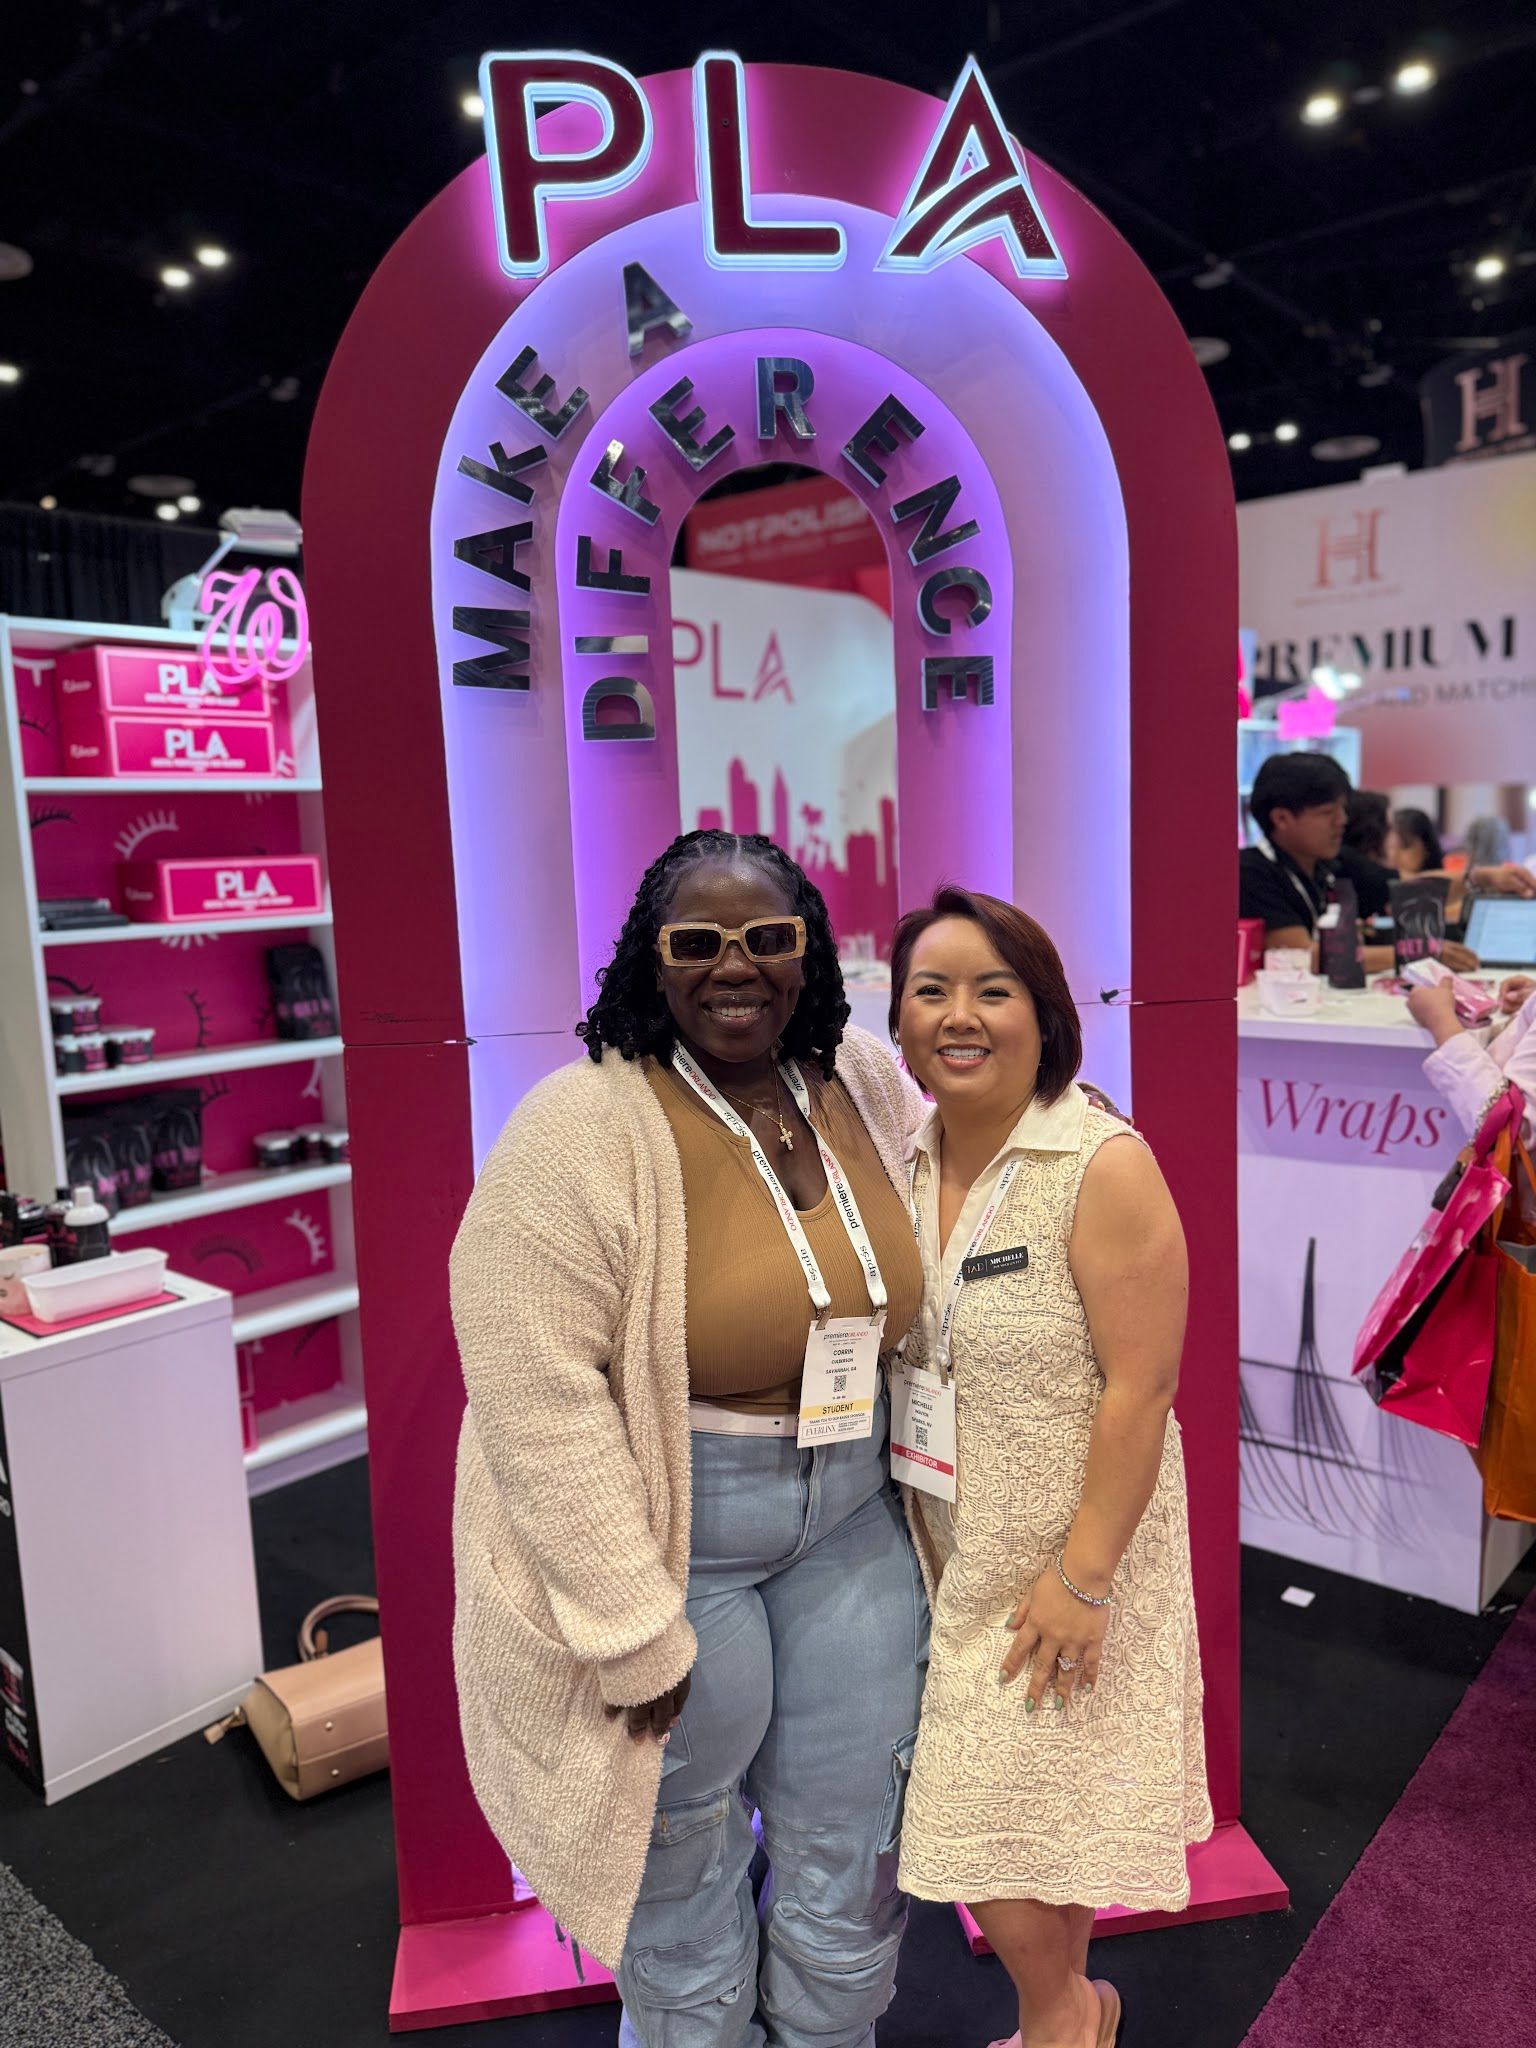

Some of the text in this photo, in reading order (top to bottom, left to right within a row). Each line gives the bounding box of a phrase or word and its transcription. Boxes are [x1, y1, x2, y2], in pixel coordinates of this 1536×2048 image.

[479, 50, 1068, 279] PLA
[453, 261, 694, 692] MAKE A
[575, 356, 995, 743] DIFFERENCE
[158, 663, 223, 697] PLA
[165, 728, 230, 761] PLA
[215, 870, 278, 901] PLA
[1259, 1077, 1447, 1156] Wraps
[990, 1252, 1025, 1265] MICHELLE
[822, 1402, 855, 1416] STUDENT
[911, 1398, 933, 1412] MICHELLE
[905, 1448, 939, 1469] EXHIBITOR
